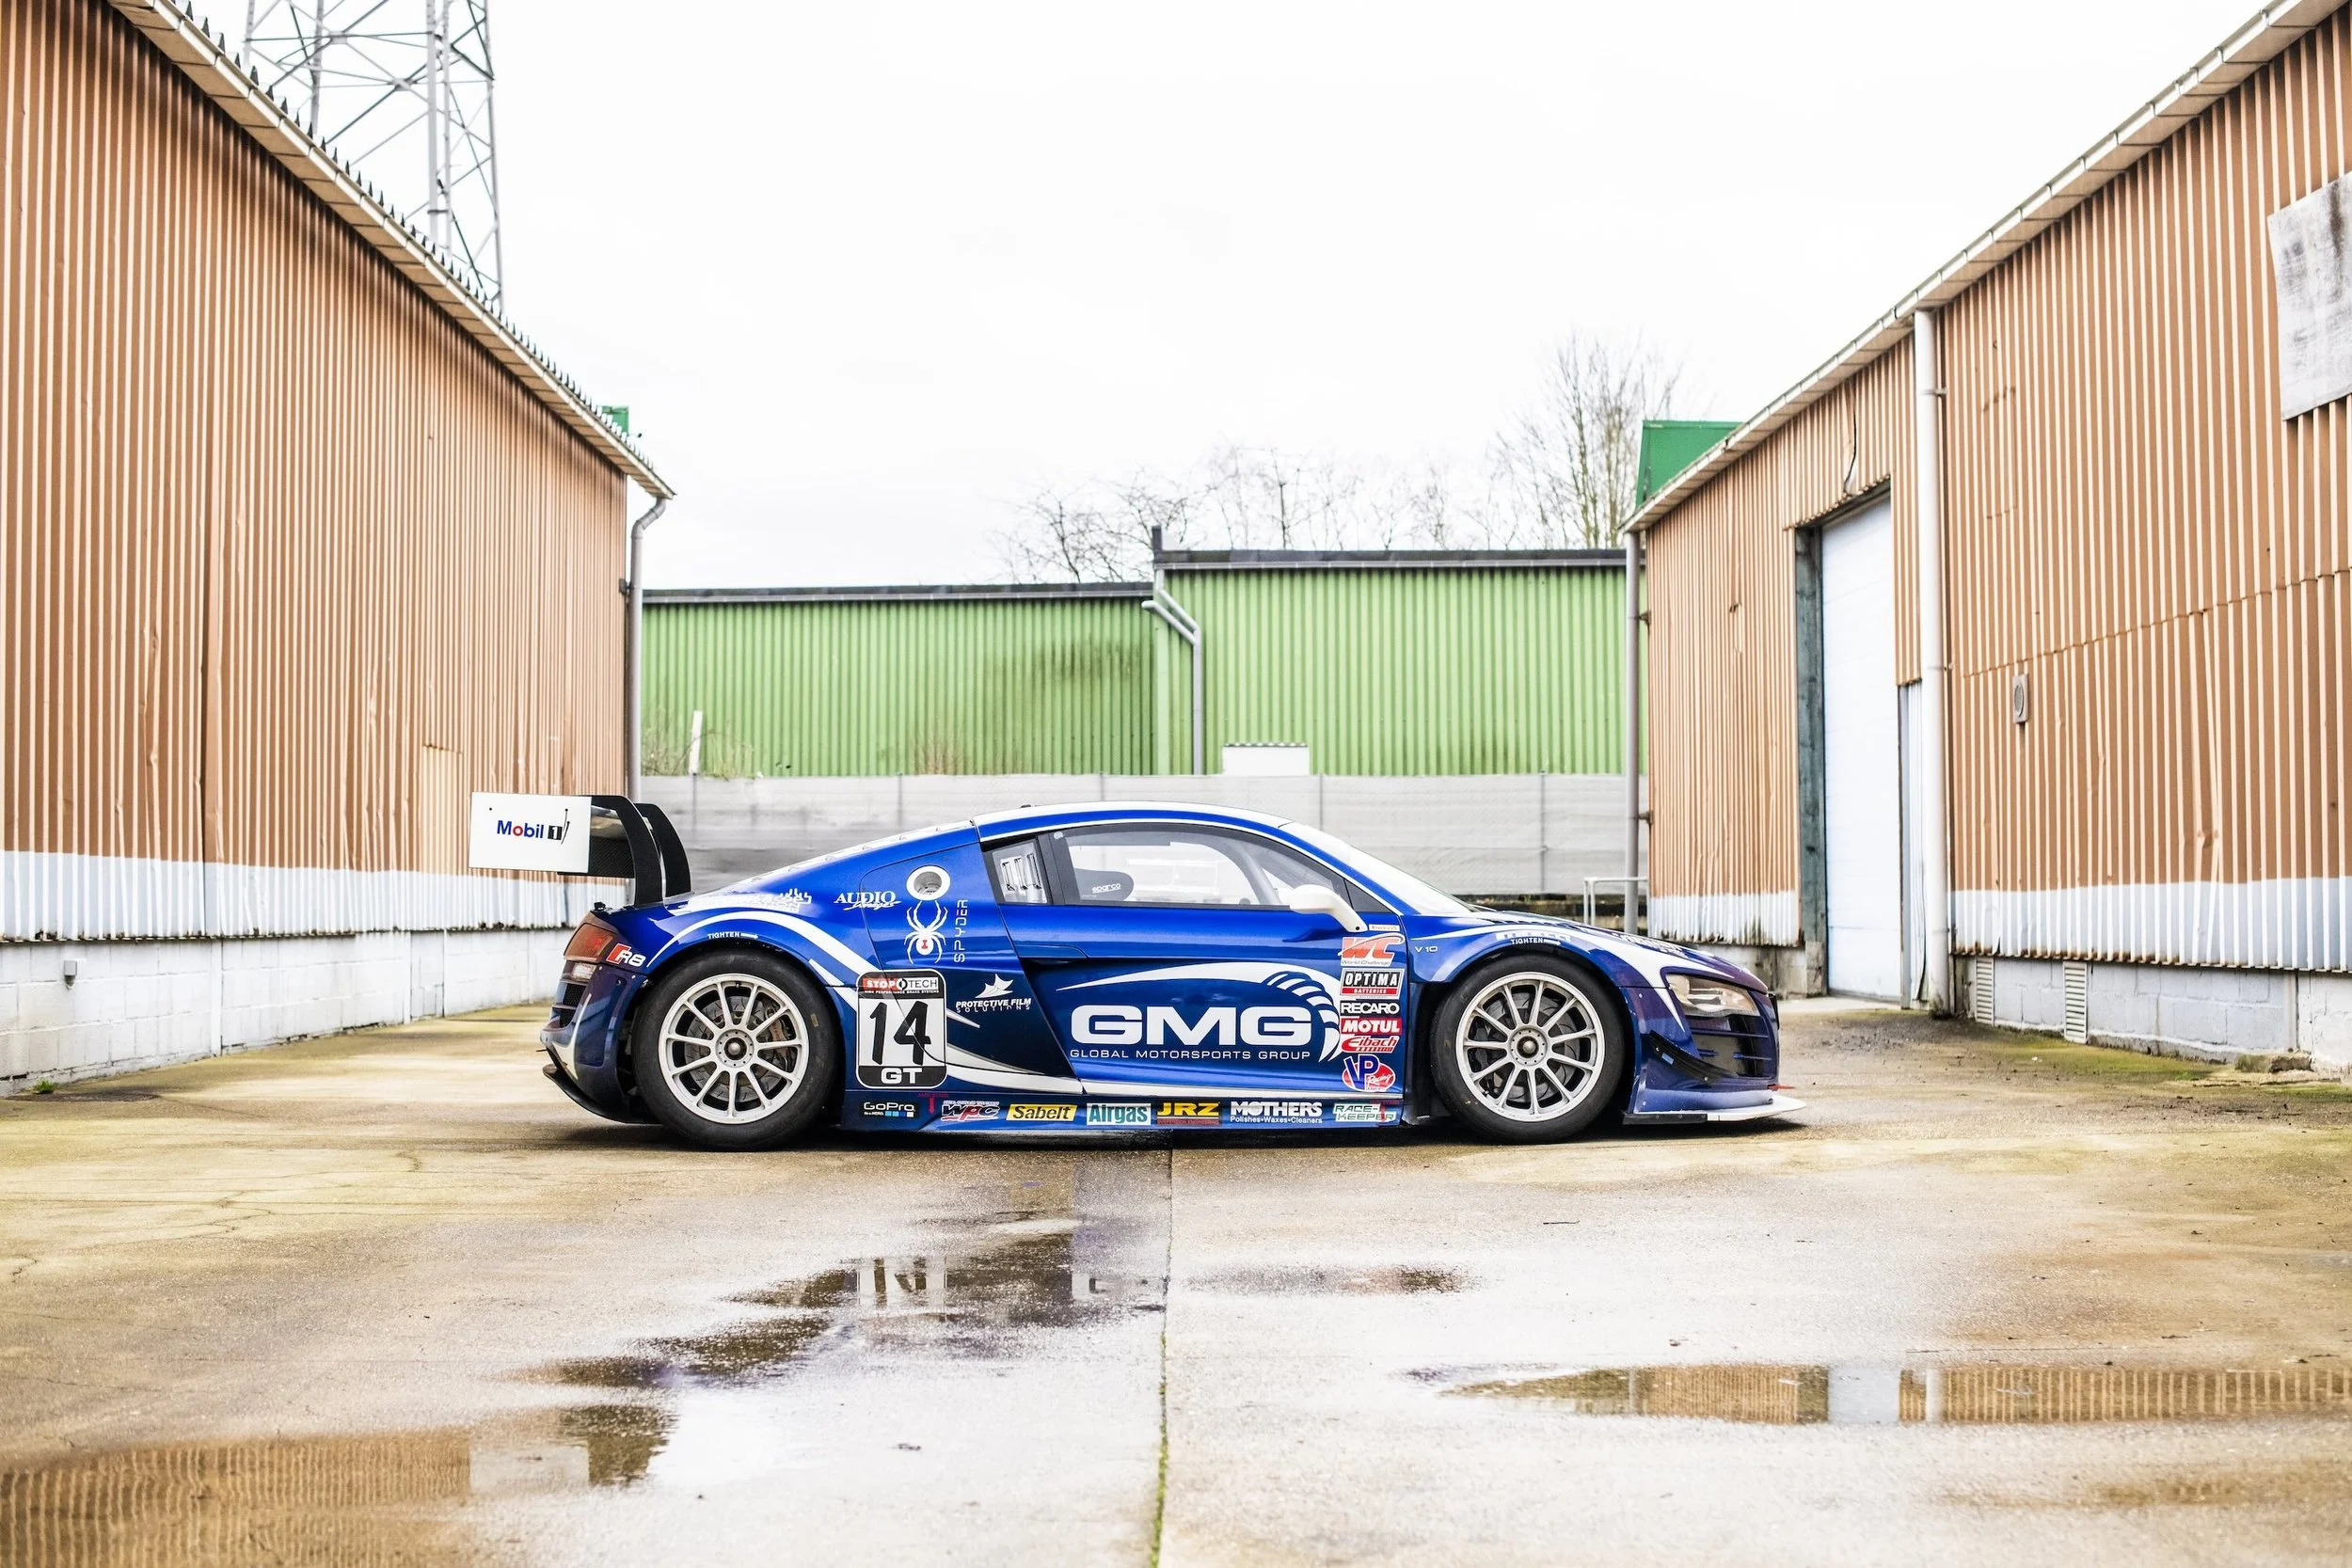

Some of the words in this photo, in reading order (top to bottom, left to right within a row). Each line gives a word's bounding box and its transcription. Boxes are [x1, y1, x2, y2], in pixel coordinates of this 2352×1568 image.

[497, 820, 545, 839] Mobil
[834, 891, 897, 904] AUDIO
[707, 931, 740, 940] TIGHTEN
[614, 949, 647, 967] R8
[1344, 973, 1398, 987] OPTIMA
[955, 1000, 1009, 1008] PROTECTIVE
[1341, 1003, 1400, 1014] RECARO
[1071, 1005, 1311, 1046] GMG
[1342, 1020, 1400, 1033] MOTUL
[869, 1001, 931, 1066] 14
[1342, 1037, 1398, 1051] Eibach
[1070, 1049, 1129, 1058] GLOBAL
[1136, 1050, 1251, 1059] MOTORSPORTS
[1258, 1051, 1311, 1060] GROUP
[881, 1067, 922, 1085] GT
[1343, 1053, 1380, 1090] VP
[864, 1101, 915, 1112] GoPro
[1012, 1105, 1073, 1119] Sabelt
[1089, 1104, 1148, 1123] Airgas
[1157, 1102, 1219, 1117] JRZ
[1231, 1101, 1323, 1117] MOTHERS
[1337, 1113, 1394, 1121] KEEPER
